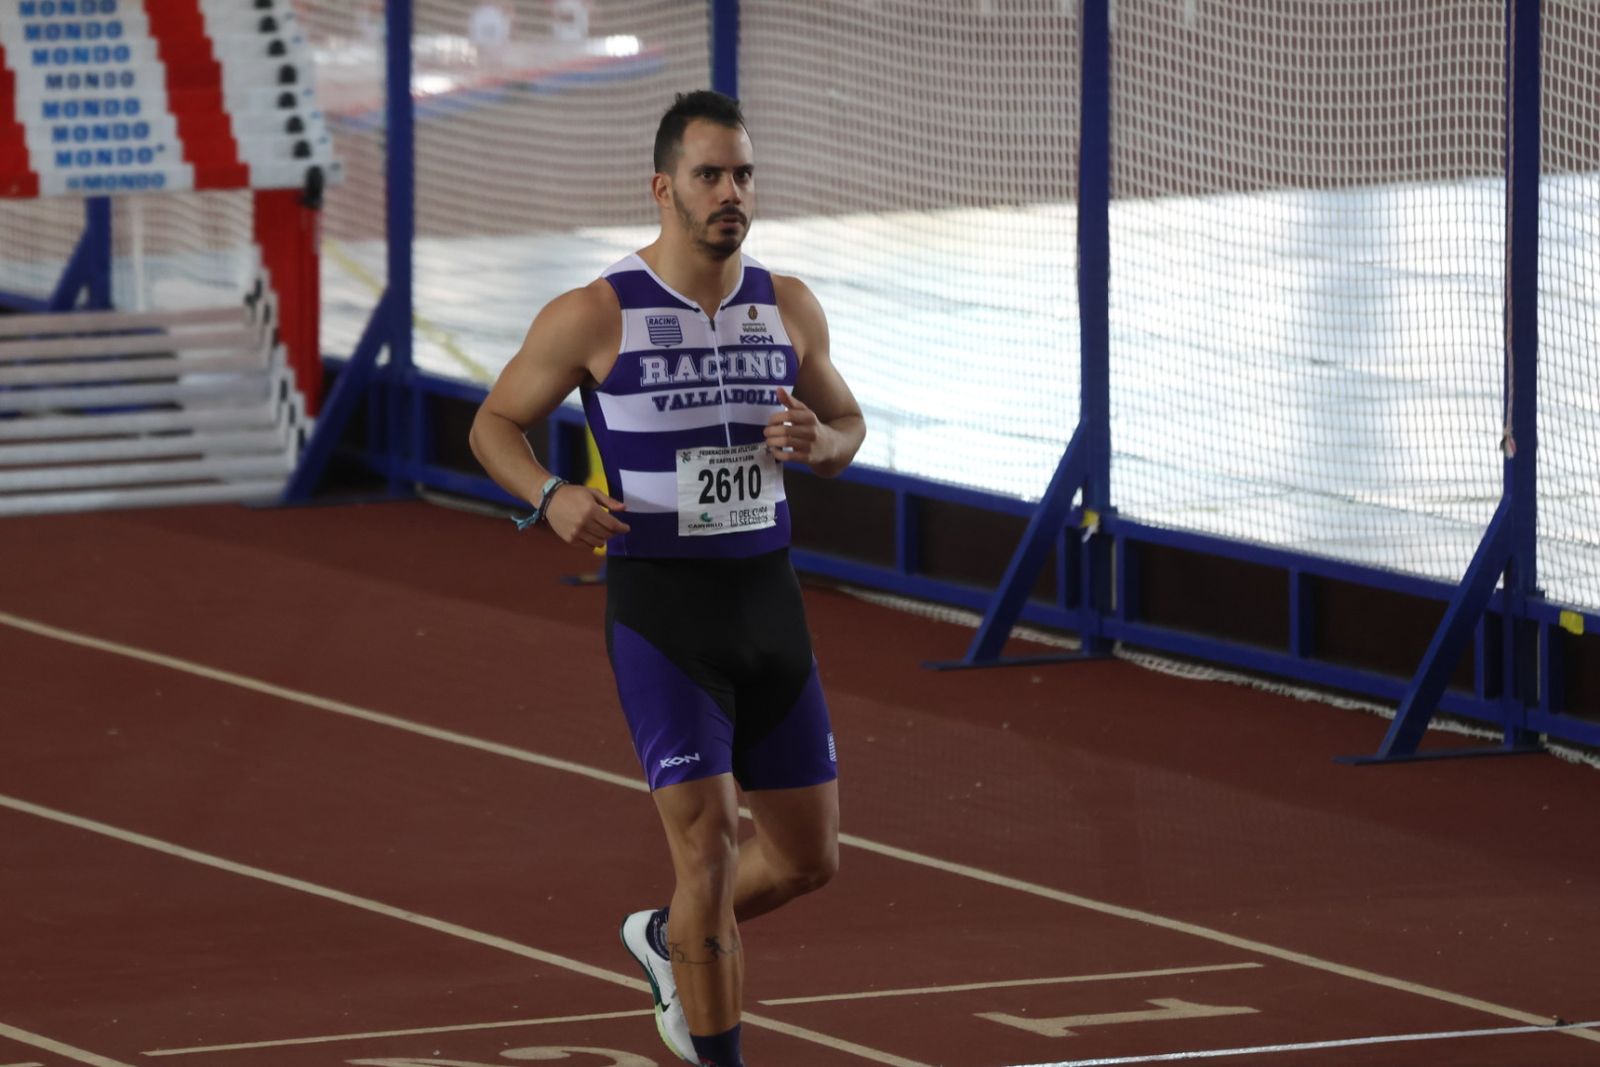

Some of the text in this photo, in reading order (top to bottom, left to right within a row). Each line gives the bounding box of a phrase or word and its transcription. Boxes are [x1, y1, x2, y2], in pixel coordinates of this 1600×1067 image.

[19, 0, 117, 16] MONDO
[24, 21, 123, 41] MONDO
[32, 45, 131, 66] MONDO
[45, 71, 135, 90] MONDO
[42, 98, 140, 118] MONDO
[52, 122, 149, 142] MONDO
[648, 317, 677, 326] RACING
[641, 350, 787, 387] RACING
[652, 389, 782, 412] VALLADOLI
[698, 464, 761, 504] 2610
